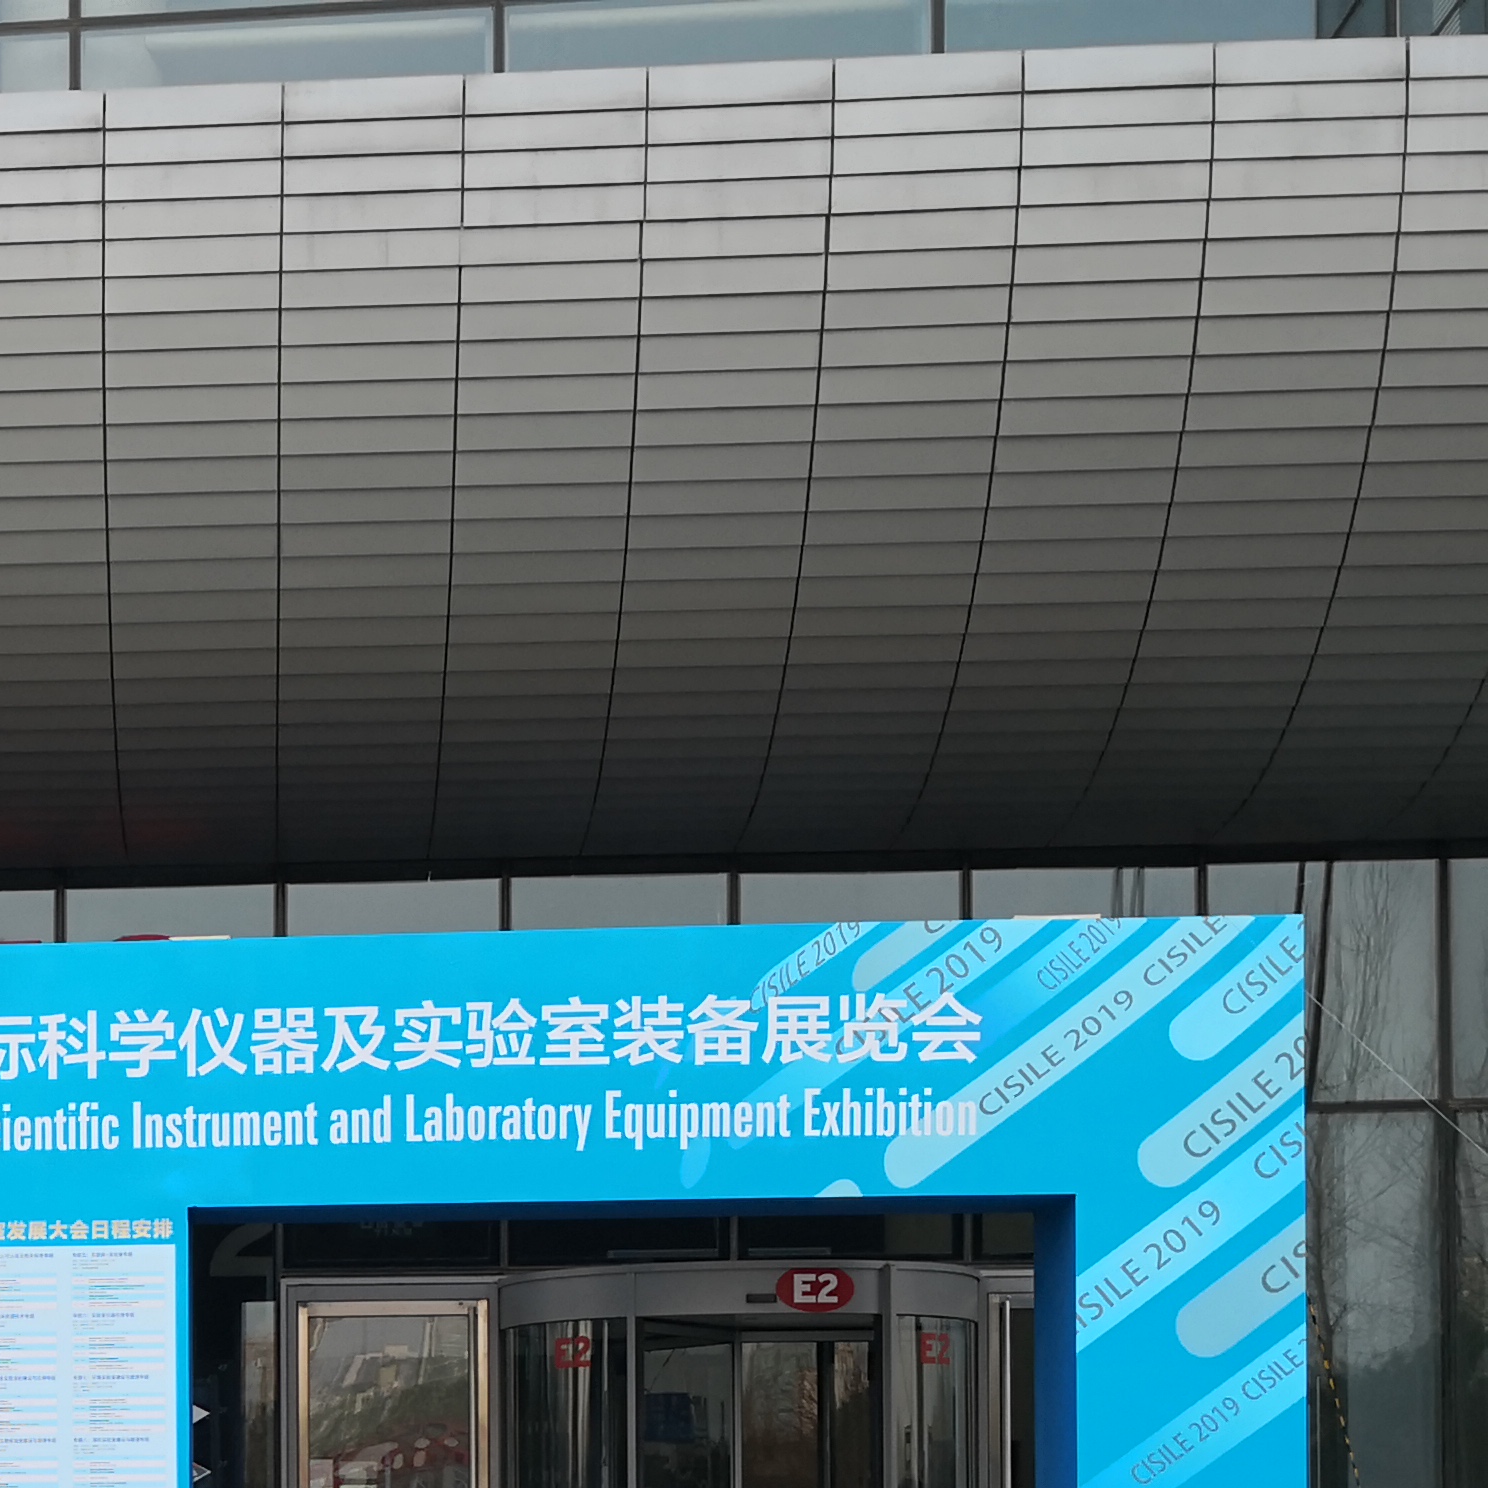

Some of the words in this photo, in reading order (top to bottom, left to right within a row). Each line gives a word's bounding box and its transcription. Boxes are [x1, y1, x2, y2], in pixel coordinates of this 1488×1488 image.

[925, 926, 1003, 996] 2019
[1037, 939, 1083, 991] CISILE
[1222, 936, 1304, 1016] CISILE
[979, 1044, 1066, 1116] CISILE
[1063, 989, 1134, 1051] 2019
[132, 1097, 316, 1149] Instrument
[329, 1094, 393, 1146] and
[405, 1092, 592, 1151] Laboratory
[604, 1090, 791, 1149] Equipment
[803, 1087, 977, 1138] Exhibition
[1183, 1070, 1283, 1158] CISILE
[1142, 1200, 1221, 1271] 2019
[793, 1273, 839, 1304] E2
[555, 1336, 591, 1369] E2
[920, 1333, 951, 1364] E2
[1131, 1431, 1194, 1486] CISILE
[1188, 1396, 1240, 1443] 2019
[1241, 1349, 1304, 1401] CISILE
